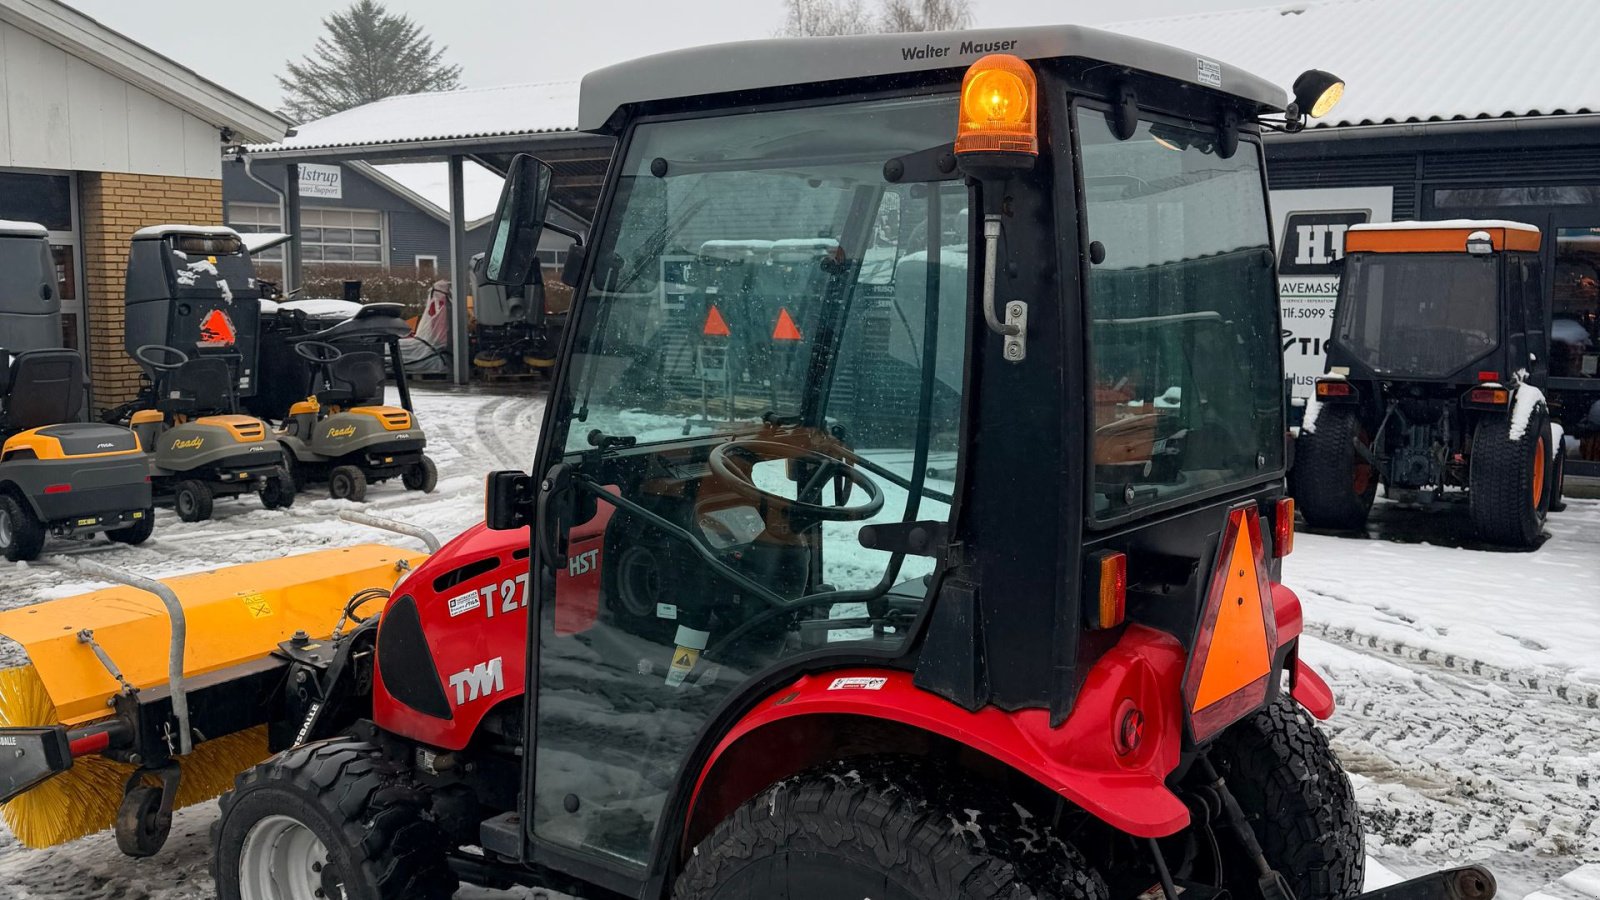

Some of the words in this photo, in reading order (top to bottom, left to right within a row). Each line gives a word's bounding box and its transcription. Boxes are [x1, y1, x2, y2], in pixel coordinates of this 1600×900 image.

[902, 44, 950, 61] Walter
[959, 40, 1017, 55] Mauser
[325, 424, 356, 439] Ready
[170, 436, 204, 451] Ready
[569, 548, 599, 577] HST
[449, 656, 504, 706] TYM
